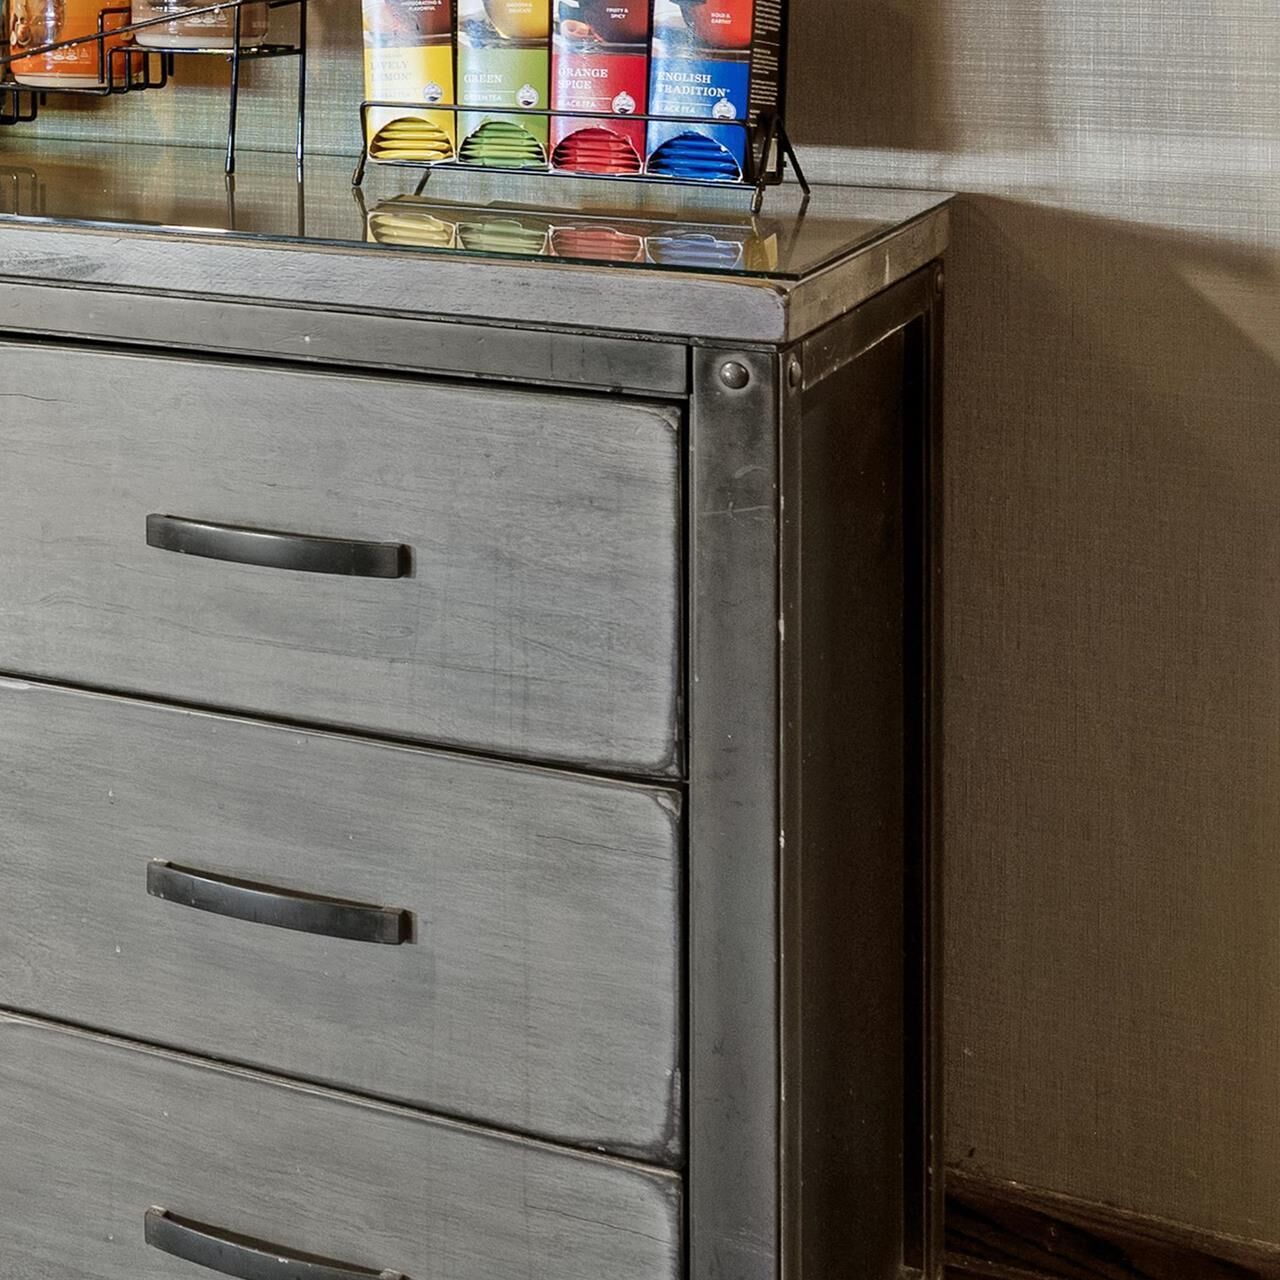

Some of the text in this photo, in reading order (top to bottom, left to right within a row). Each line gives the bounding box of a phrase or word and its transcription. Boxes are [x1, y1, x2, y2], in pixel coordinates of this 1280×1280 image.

[558, 68, 609, 78] ORANGE
[657, 72, 712, 84] ENGLISH
[558, 80, 592, 89] SPICE
